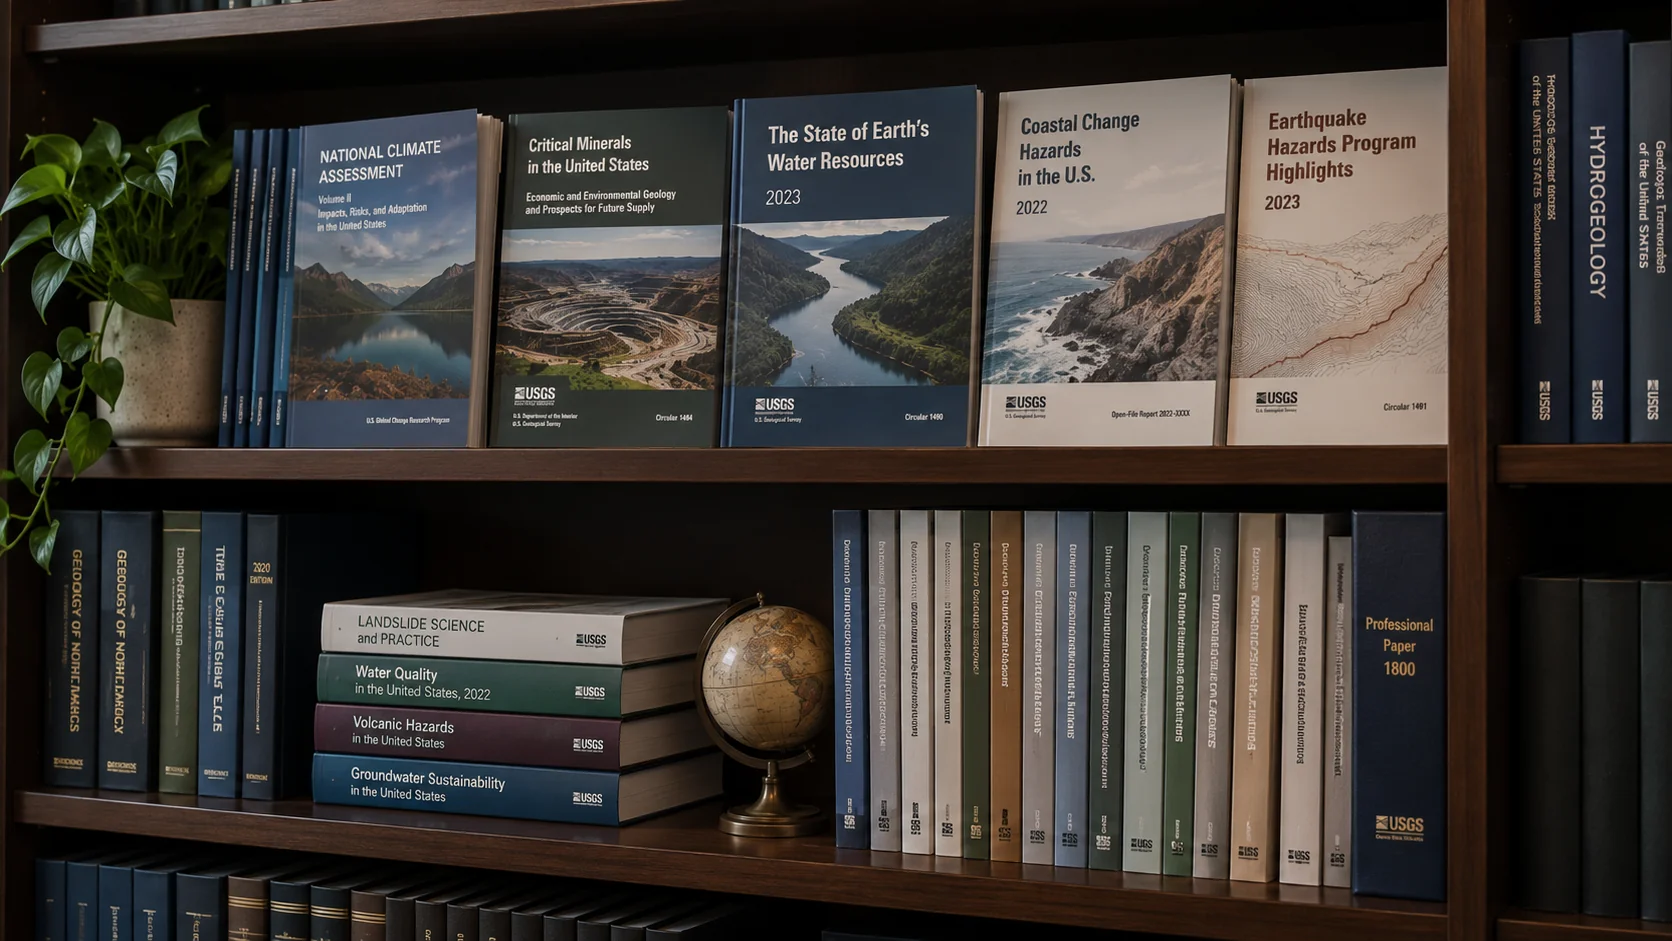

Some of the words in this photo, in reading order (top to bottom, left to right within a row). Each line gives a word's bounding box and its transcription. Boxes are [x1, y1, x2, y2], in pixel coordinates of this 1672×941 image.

[1021, 114, 1077, 135] Coastal
[1082, 113, 1140, 132] Change
[1269, 108, 1366, 132] Earthquake
[768, 126, 798, 144] The
[804, 124, 846, 142] State
[852, 122, 868, 140] of
[872, 119, 930, 140] Earth's
[320, 146, 384, 163] NATIONAL
[387, 140, 441, 158] CLIMATE
[529, 137, 573, 152] Critical
[576, 135, 632, 150] Minerals
[1020, 140, 1082, 160] Hazards
[1268, 136, 1336, 155] Hazards
[1342, 134, 1416, 154] Program
[528, 160, 538, 174] in
[542, 160, 562, 174] the
[566, 158, 605, 172] United
[609, 157, 649, 172] States
[768, 154, 816, 172] Water
[820, 152, 904, 169] Resources
[319, 164, 404, 184] ASSESSMENT
[1018, 169, 1032, 186] in
[1036, 168, 1060, 185] the
[1065, 165, 1095, 183] U.S.
[1266, 160, 1354, 184] Highlights
[318, 194, 345, 204] Volume
[526, 192, 564, 202] Economic
[566, 192, 582, 200] and
[584, 190, 640, 200] Environmental
[643, 190, 676, 200] Geology
[766, 189, 800, 206] 2023
[1265, 194, 1300, 210] 2023
[318, 209, 348, 219] Impacts,
[350, 207, 370, 216] Risks,
[373, 206, 386, 215] and
[388, 202, 428, 215] Adaptation
[526, 206, 540, 214] and
[542, 205, 582, 216] Prospects
[584, 204, 596, 212] for
[598, 203, 624, 212] Future
[627, 202, 655, 214] Supply
[1016, 200, 1048, 215] 2022
[317, 223, 324, 232] in
[326, 222, 338, 231] the
[340, 221, 362, 230] United
[364, 220, 386, 228] States
[526, 387, 556, 400] USGS
[1018, 396, 1046, 408] USGS
[1268, 392, 1298, 404] USGS
[766, 398, 794, 410] USGS
[1540, 392, 1550, 420] USGS
[1592, 392, 1603, 420] USGS
[1648, 392, 1659, 420] USGS
[71, 621, 81, 638] OF
[116, 620, 126, 638] OF
[358, 615, 427, 630] LANDSLIDE
[430, 618, 484, 632] SCIENCE
[1366, 616, 1434, 632] Professional
[358, 633, 378, 644] and
[381, 634, 440, 647] PRACTICE
[584, 634, 606, 644] USGS
[1384, 638, 1416, 655] Paper
[356, 665, 392, 678] Water
[394, 666, 438, 684] Quality
[1384, 661, 1416, 676] 1800
[355, 682, 364, 694] in
[367, 684, 384, 696] the
[386, 684, 421, 696] United
[424, 686, 460, 700] States,
[464, 688, 490, 700] 2022
[584, 686, 606, 696] USGS
[354, 716, 402, 730] Volcanic
[406, 718, 454, 734] Hazards
[352, 732, 361, 744] in
[364, 734, 378, 744] the
[382, 735, 412, 746] United
[414, 736, 445, 748] States
[582, 739, 604, 750] USGS
[351, 766, 425, 784] Groundwater
[428, 772, 506, 792] Sustainability
[350, 785, 360, 796] in
[362, 786, 378, 797] the
[380, 787, 412, 800] United
[414, 790, 446, 802] States
[581, 792, 602, 804] USGS
[1390, 816, 1424, 832] USGS
